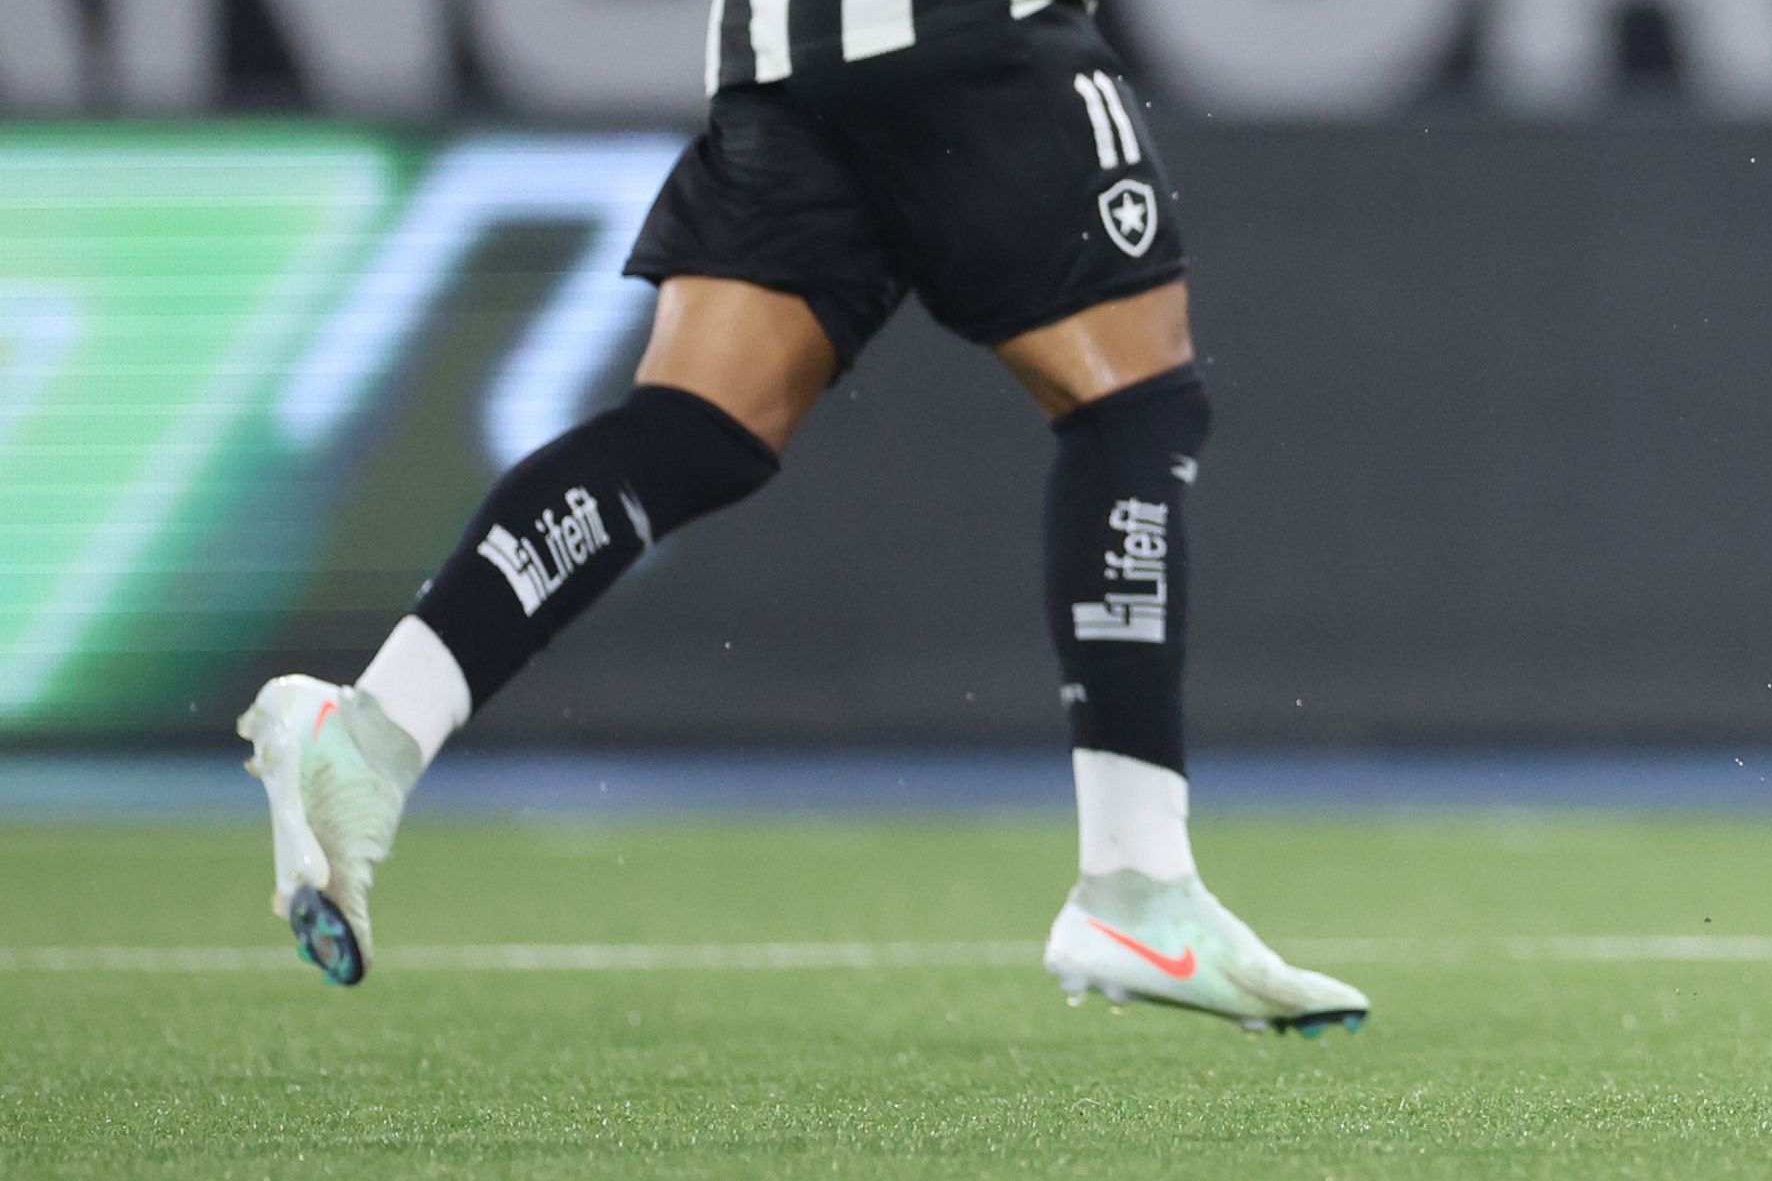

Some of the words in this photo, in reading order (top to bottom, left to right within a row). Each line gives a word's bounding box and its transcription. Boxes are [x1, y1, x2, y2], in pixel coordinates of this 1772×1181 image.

[1073, 69, 1141, 169] 11
[520, 486, 611, 595] Lifefit
[1103, 496, 1169, 607] Lifefit
